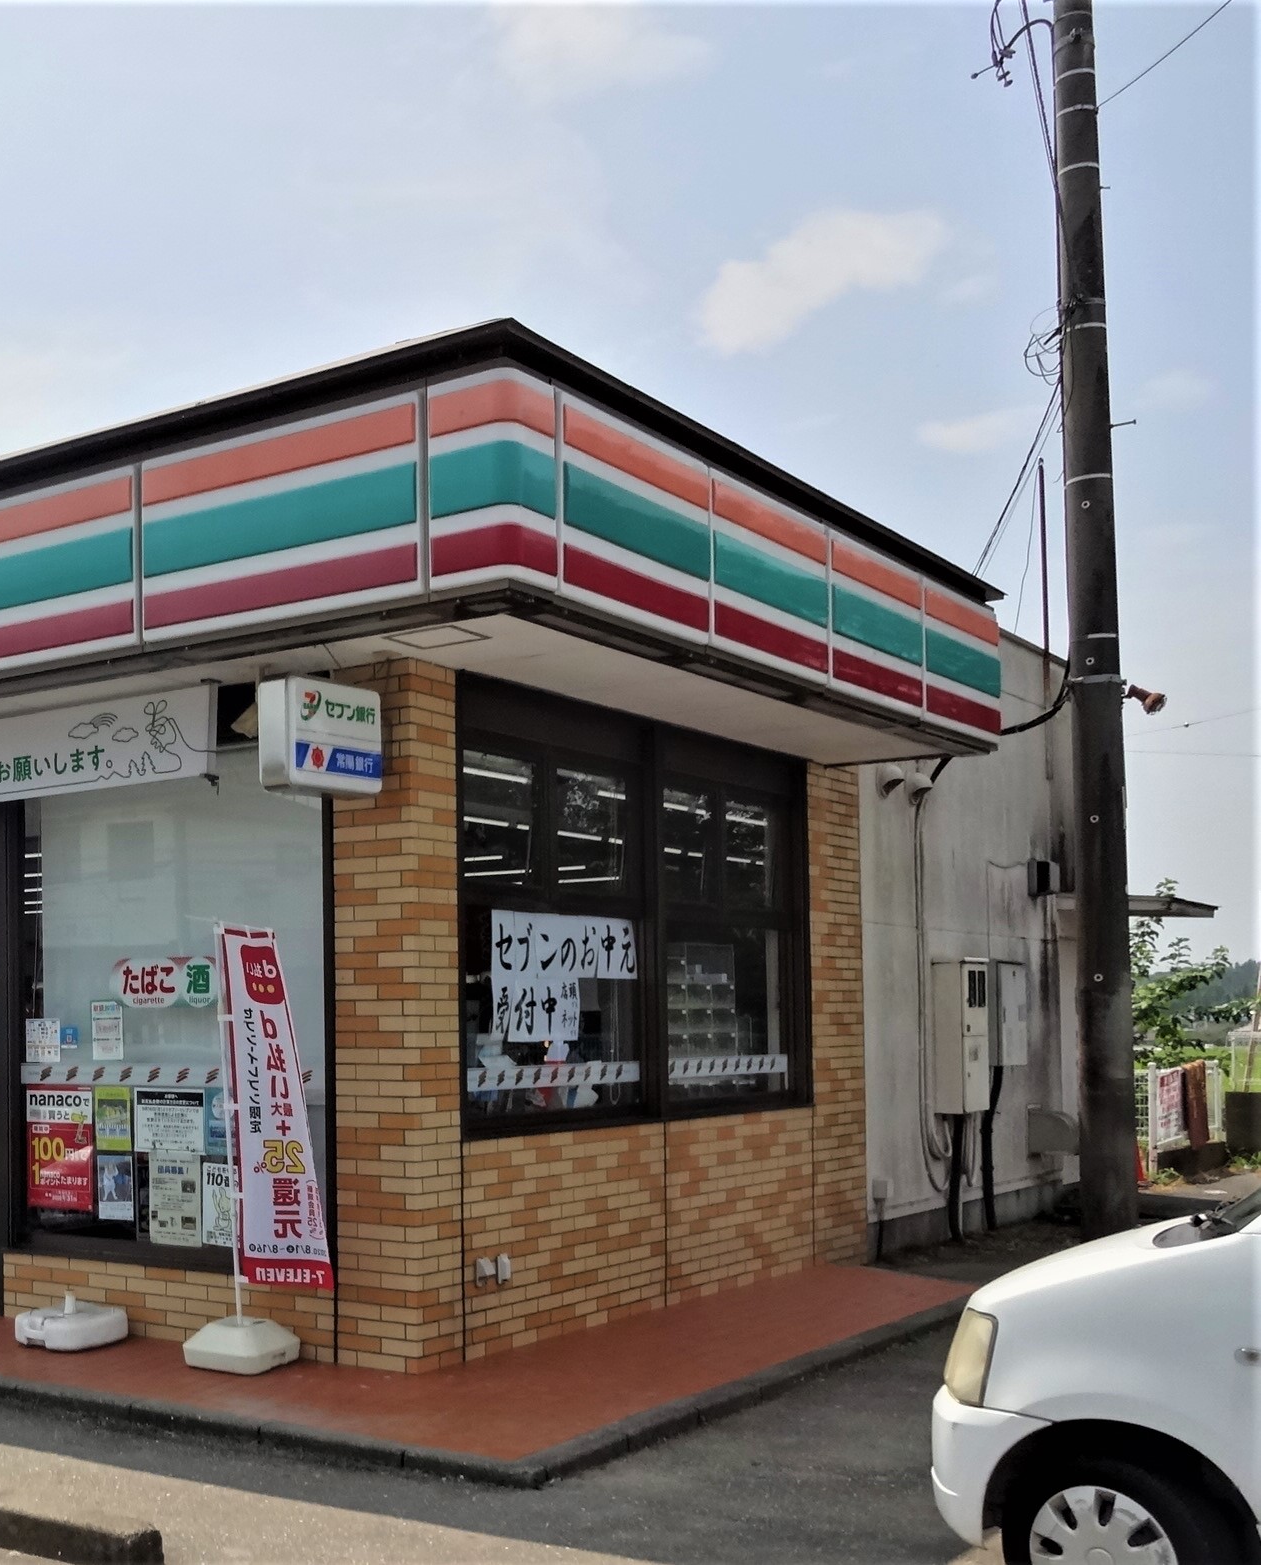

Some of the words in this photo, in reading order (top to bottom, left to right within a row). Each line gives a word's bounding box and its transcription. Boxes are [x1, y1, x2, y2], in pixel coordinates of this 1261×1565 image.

[325, 699, 376, 725] セブン銀行
[123, 964, 175, 994] たばこ
[186, 964, 210, 994] 酒
[133, 996, 165, 1005] cigarette
[190, 996, 211, 1005] liquor
[496, 986, 557, 1036] 受付中
